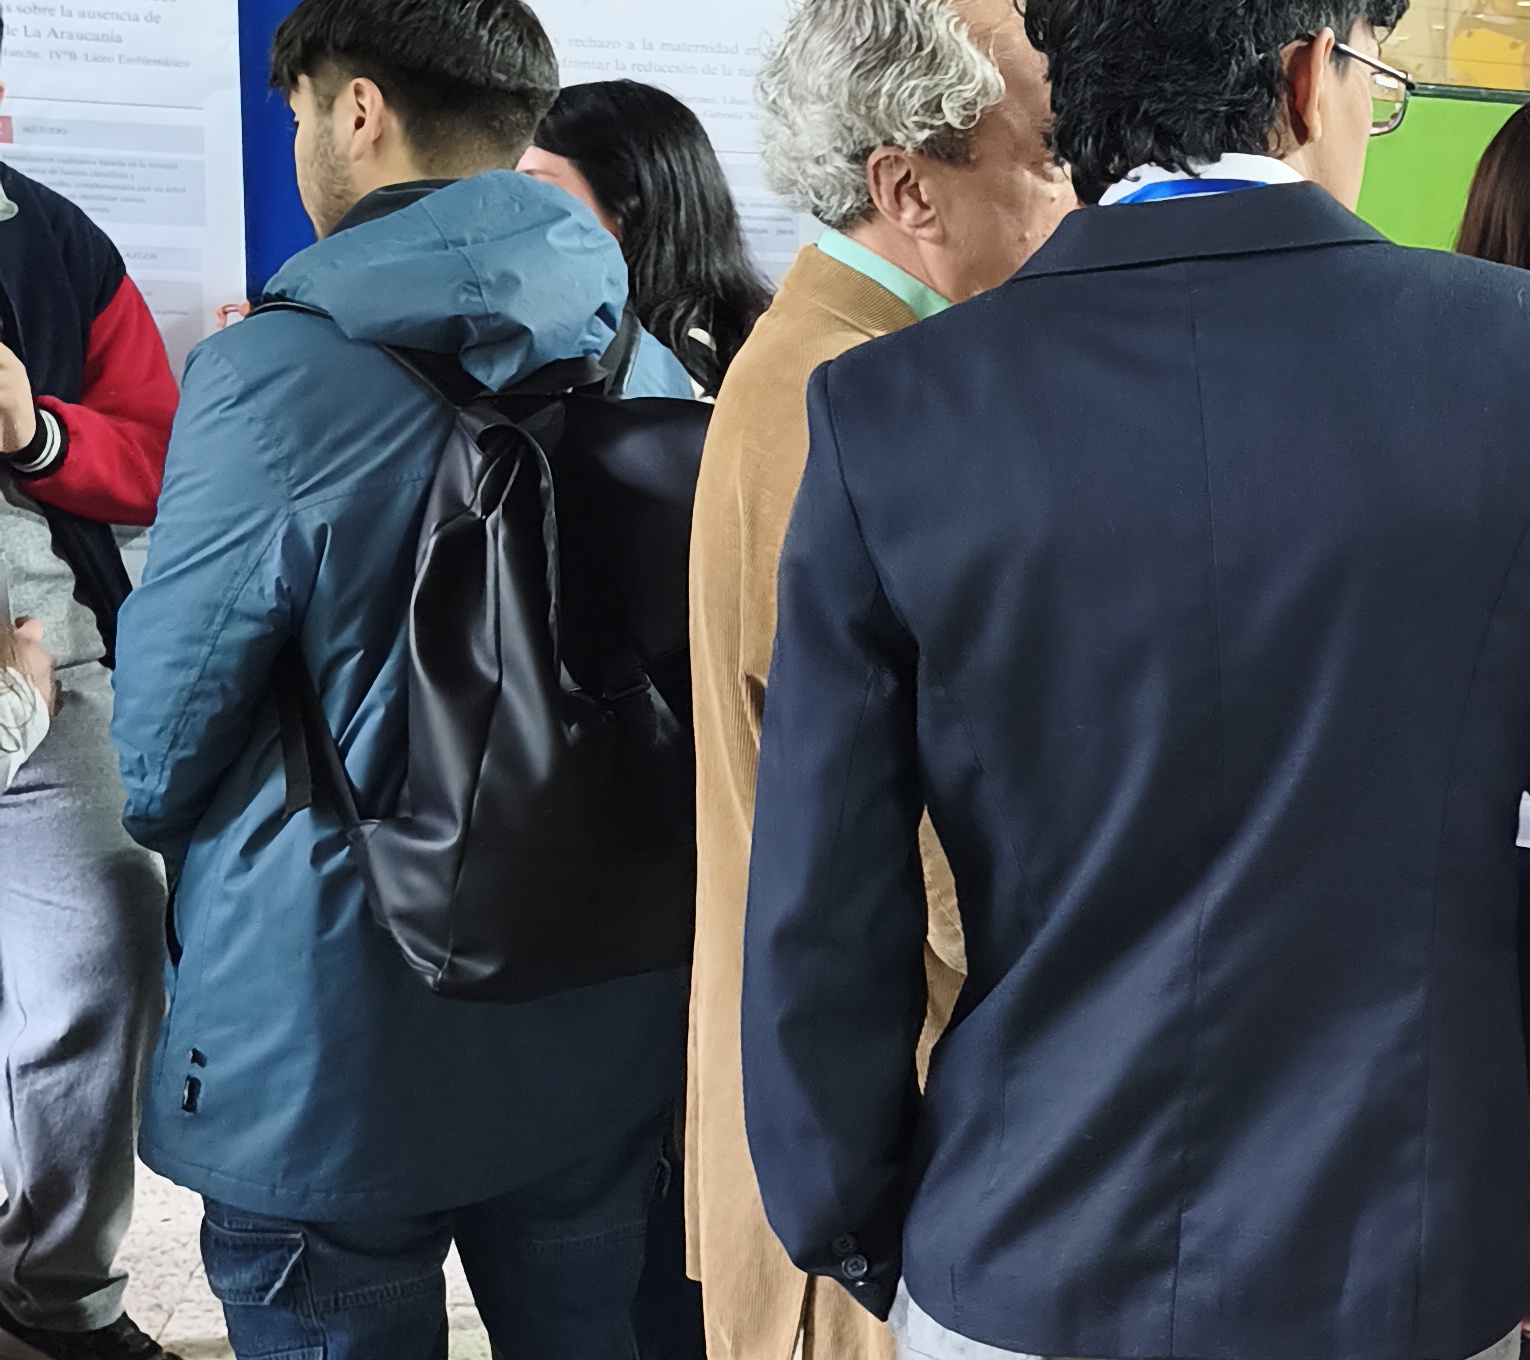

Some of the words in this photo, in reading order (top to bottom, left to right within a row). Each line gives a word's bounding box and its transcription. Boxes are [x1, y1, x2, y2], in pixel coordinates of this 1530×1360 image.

[16, 3, 56, 17] sobre
[61, 5, 73, 18] la
[78, 8, 140, 23] ausencia
[144, 11, 162, 24] de
[24, 24, 41, 38] La
[568, 36, 621, 50] rechazo
[642, 39, 653, 51] la
[660, 41, 739, 55] maternidad
[562, 56, 610, 71] frontar
[615, 59, 627, 72] la
[631, 61, 698, 75] reducción
[702, 63, 718, 76] de
[722, 64, 733, 76] la
